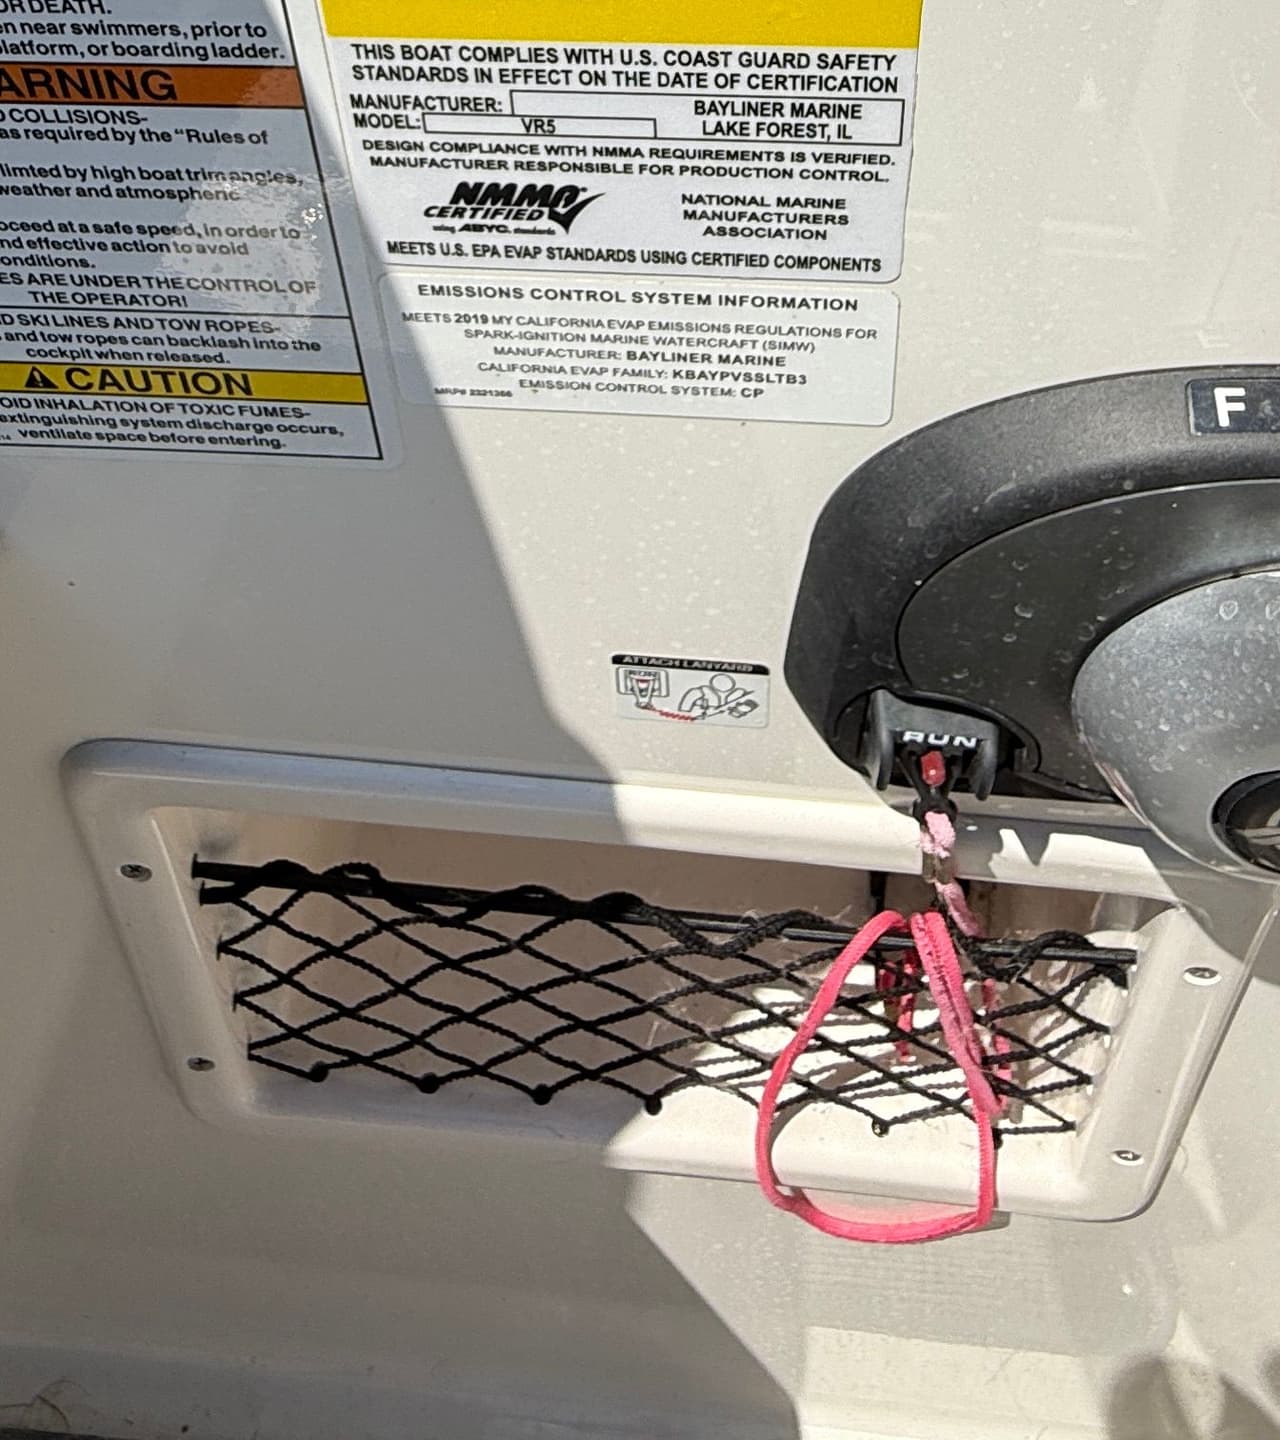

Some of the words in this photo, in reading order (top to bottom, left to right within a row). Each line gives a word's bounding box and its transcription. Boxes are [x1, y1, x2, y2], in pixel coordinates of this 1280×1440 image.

[350, 94, 503, 112] MANUFACTURER:
[694, 100, 784, 117] BAYLINER
[790, 102, 862, 119] MARINE
[354, 114, 421, 129] MODEL:
[521, 118, 556, 133] VR5
[702, 120, 750, 137] LAKE
[756, 122, 829, 139] FOREST,
[837, 124, 852, 140] IL
[682, 194, 771, 207] NATIONAL
[776, 197, 846, 210] MARINE
[424, 206, 545, 221] CERTIFIED
[683, 210, 849, 225] MANUFACTURERS
[703, 226, 827, 240] ASSOCIATION
[418, 284, 524, 299] EMISSIONS
[530, 288, 626, 303] CONTROL
[632, 291, 711, 305] SYSTEM
[719, 295, 858, 311] INFORMATION
[64, 367, 253, 396] CAUTION
[1214, 387, 1245, 427] F
[903, 731, 976, 748] RUN
